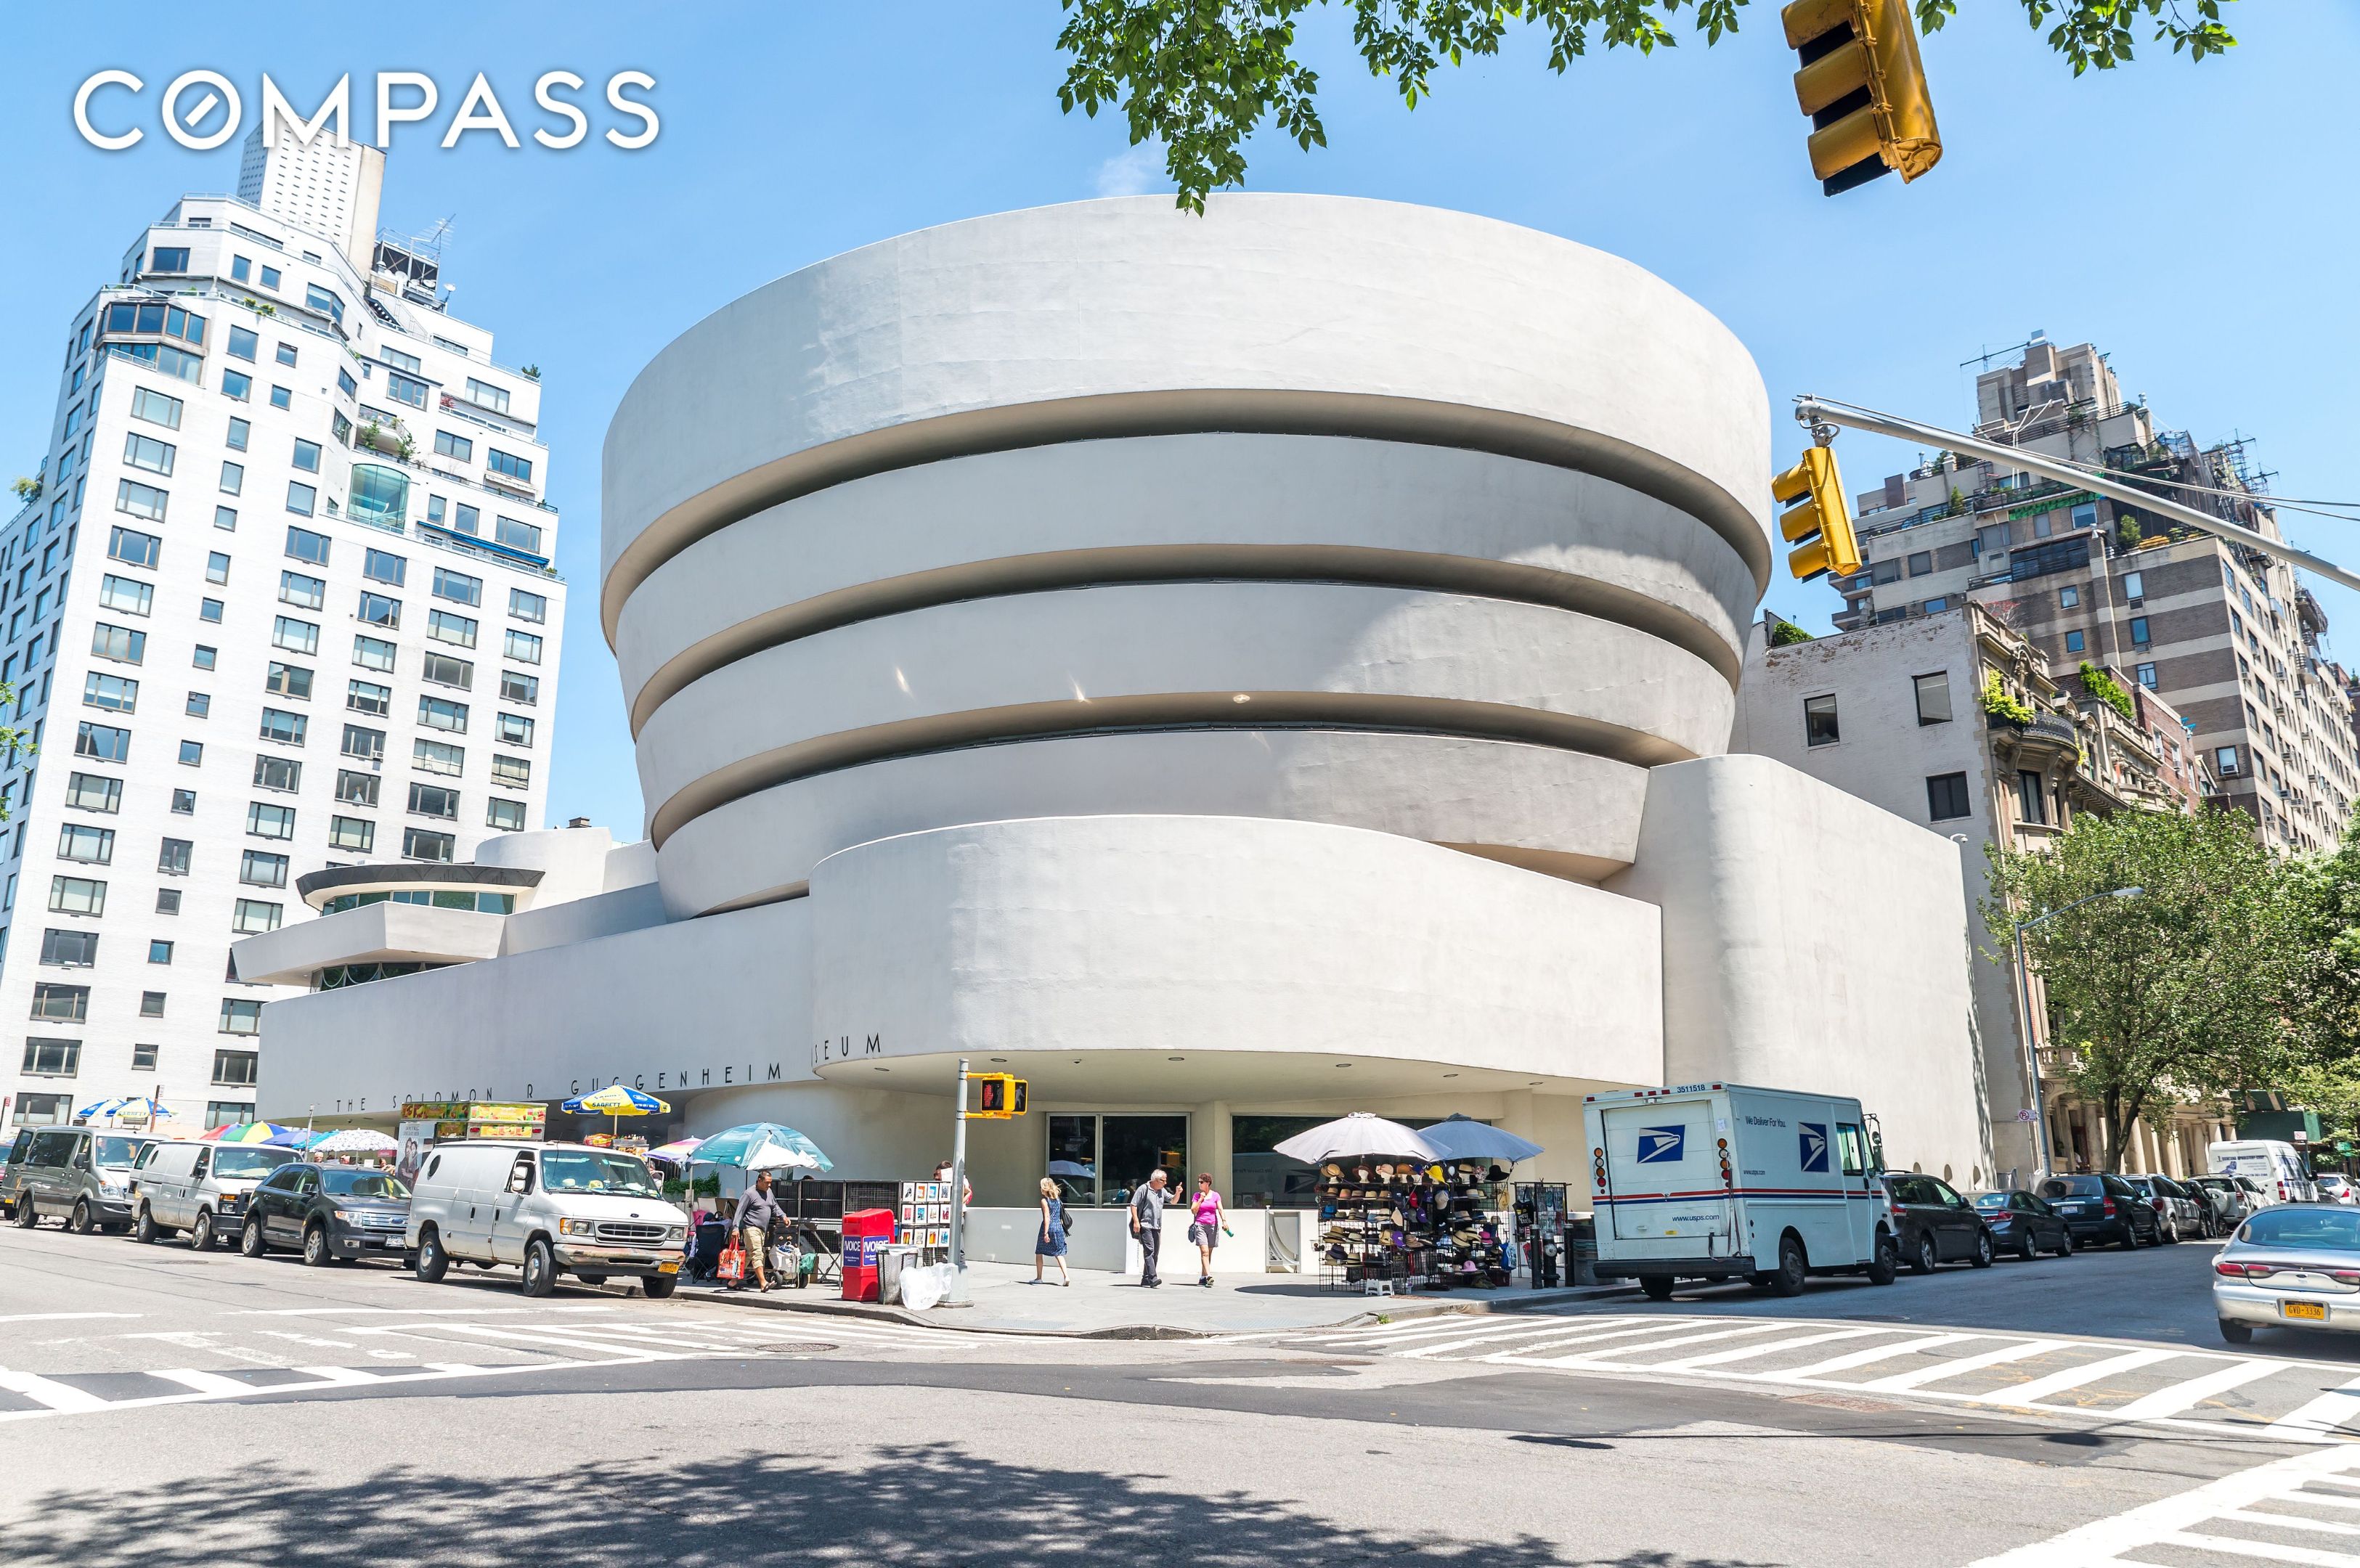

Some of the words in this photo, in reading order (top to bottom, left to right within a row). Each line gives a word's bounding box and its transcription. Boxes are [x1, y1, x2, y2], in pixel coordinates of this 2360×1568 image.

[336, 1098, 366, 1113] THE
[526, 1084, 533, 1099] R
[811, 1032, 881, 1066] SEUM
[1677, 1084, 1706, 1093] 3511518
[1745, 1116, 1753, 1125] We
[1754, 1116, 1769, 1127] Deliver
[1672, 1214, 1720, 1222] www.usps.com
[845, 1240, 860, 1251] VOICE
